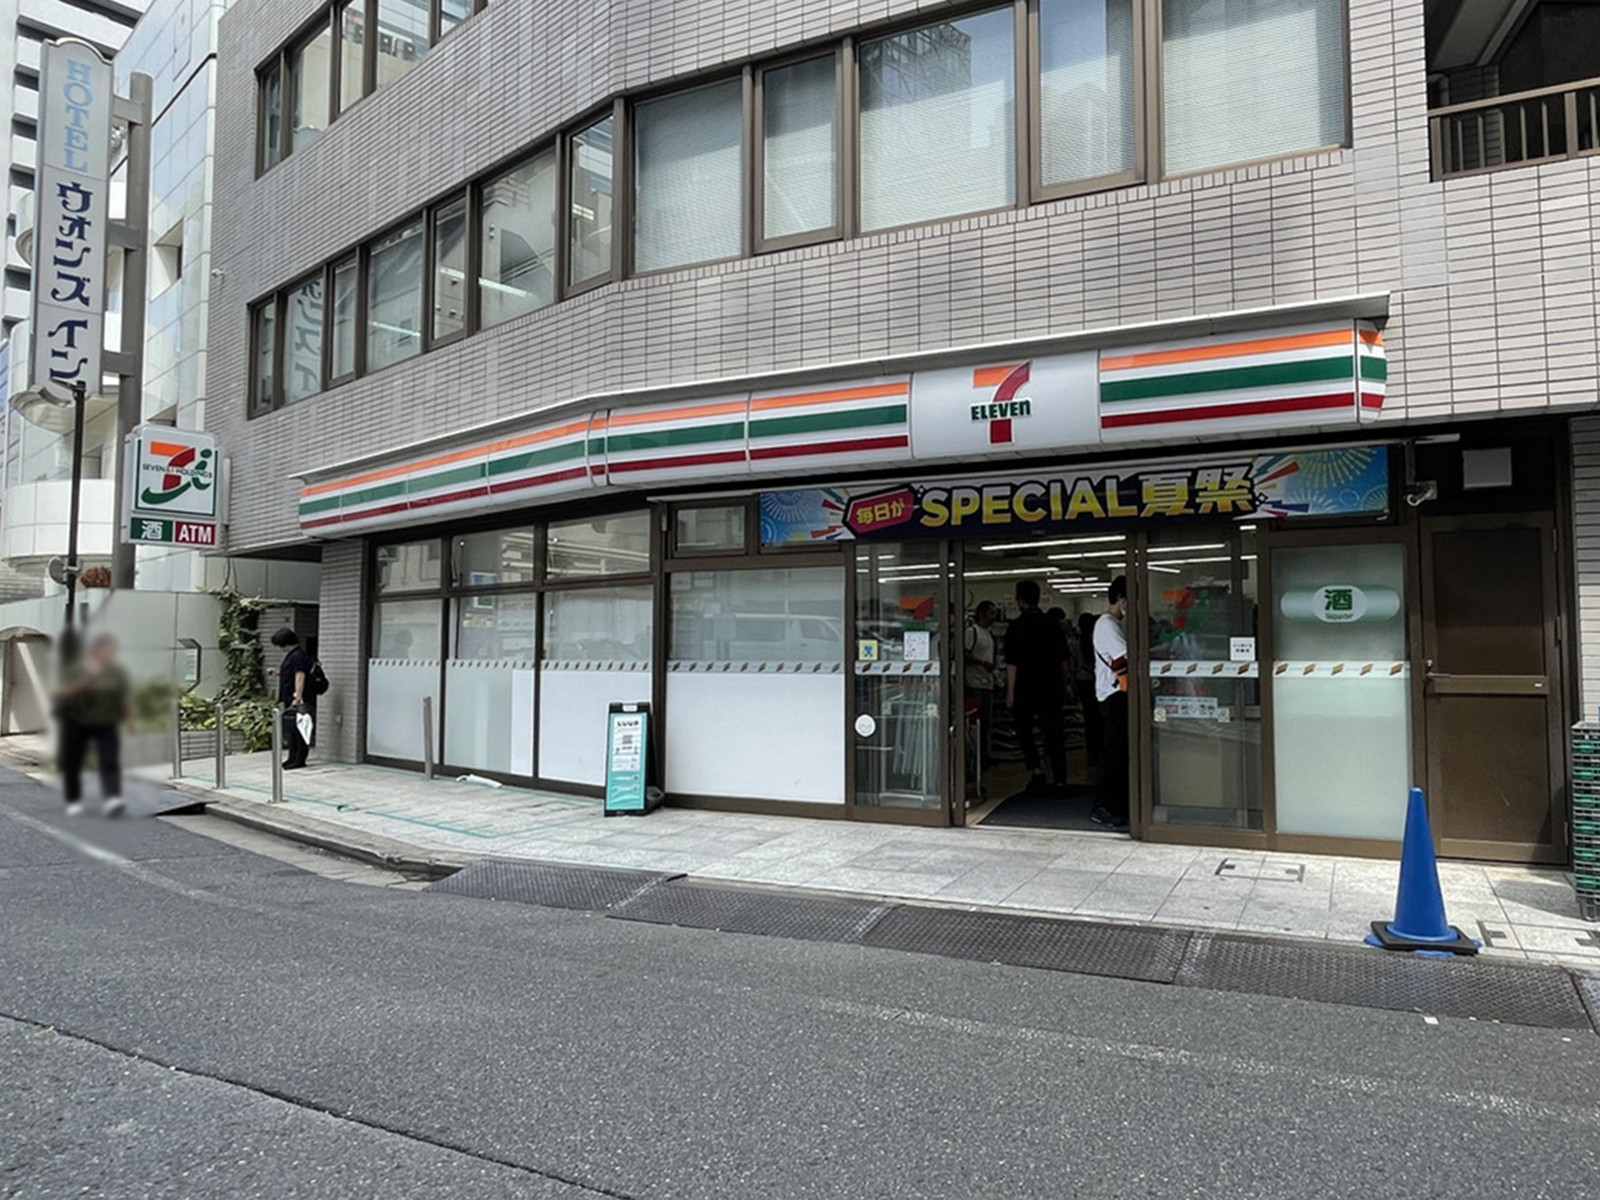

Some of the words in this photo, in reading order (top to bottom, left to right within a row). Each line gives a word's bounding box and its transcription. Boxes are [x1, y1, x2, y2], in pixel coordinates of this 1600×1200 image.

[63, 59, 93, 173] HOTEL
[920, 478, 1138, 527] SPECIAL
[1139, 465, 1254, 517] 夏祭
[856, 498, 905, 525] 毎日が
[141, 520, 163, 540] 酒
[178, 524, 212, 543] ATM
[1324, 589, 1353, 610] 酒
